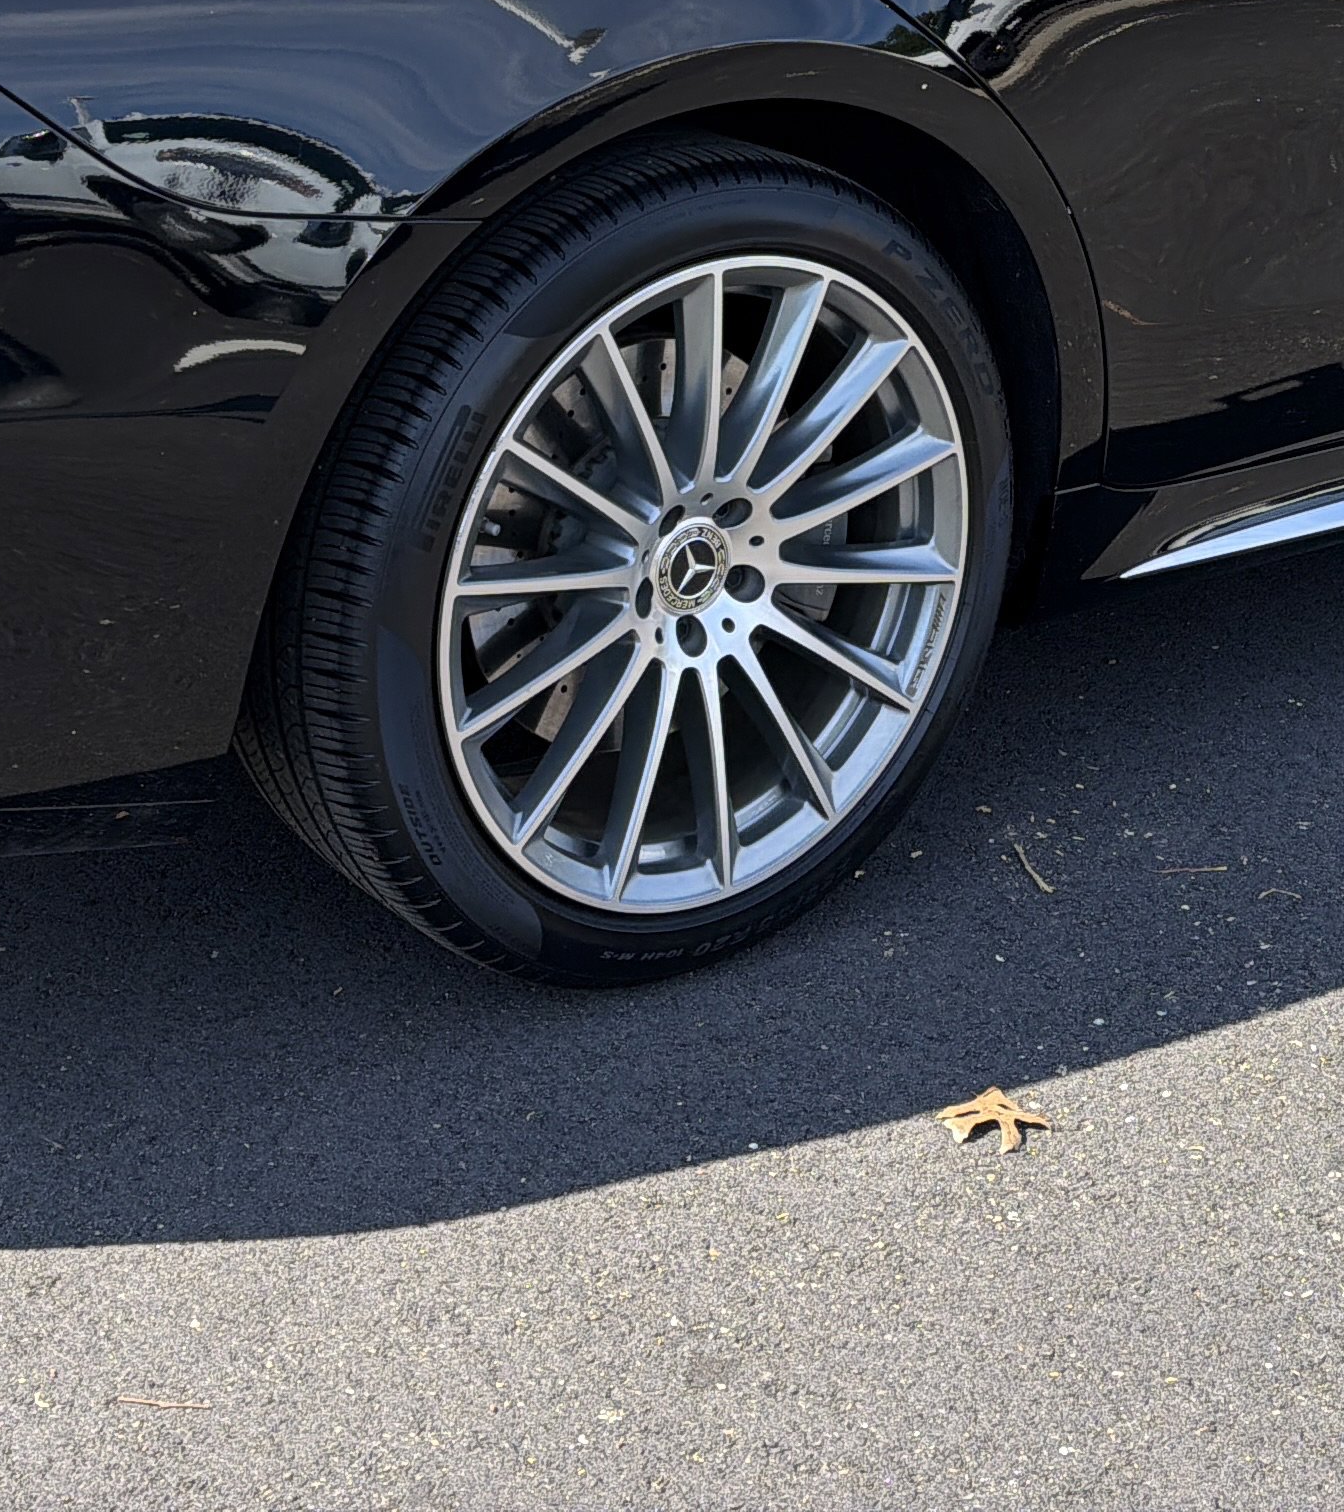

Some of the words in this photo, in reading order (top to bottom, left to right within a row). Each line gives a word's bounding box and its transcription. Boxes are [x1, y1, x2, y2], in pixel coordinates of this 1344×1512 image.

[915, 266, 994, 396] ZERO
[413, 405, 488, 553] PIRELLI
[701, 529, 722, 548] BENZ
[659, 577, 696, 609] MERCEDES
[398, 782, 443, 866] OUTSIDE
